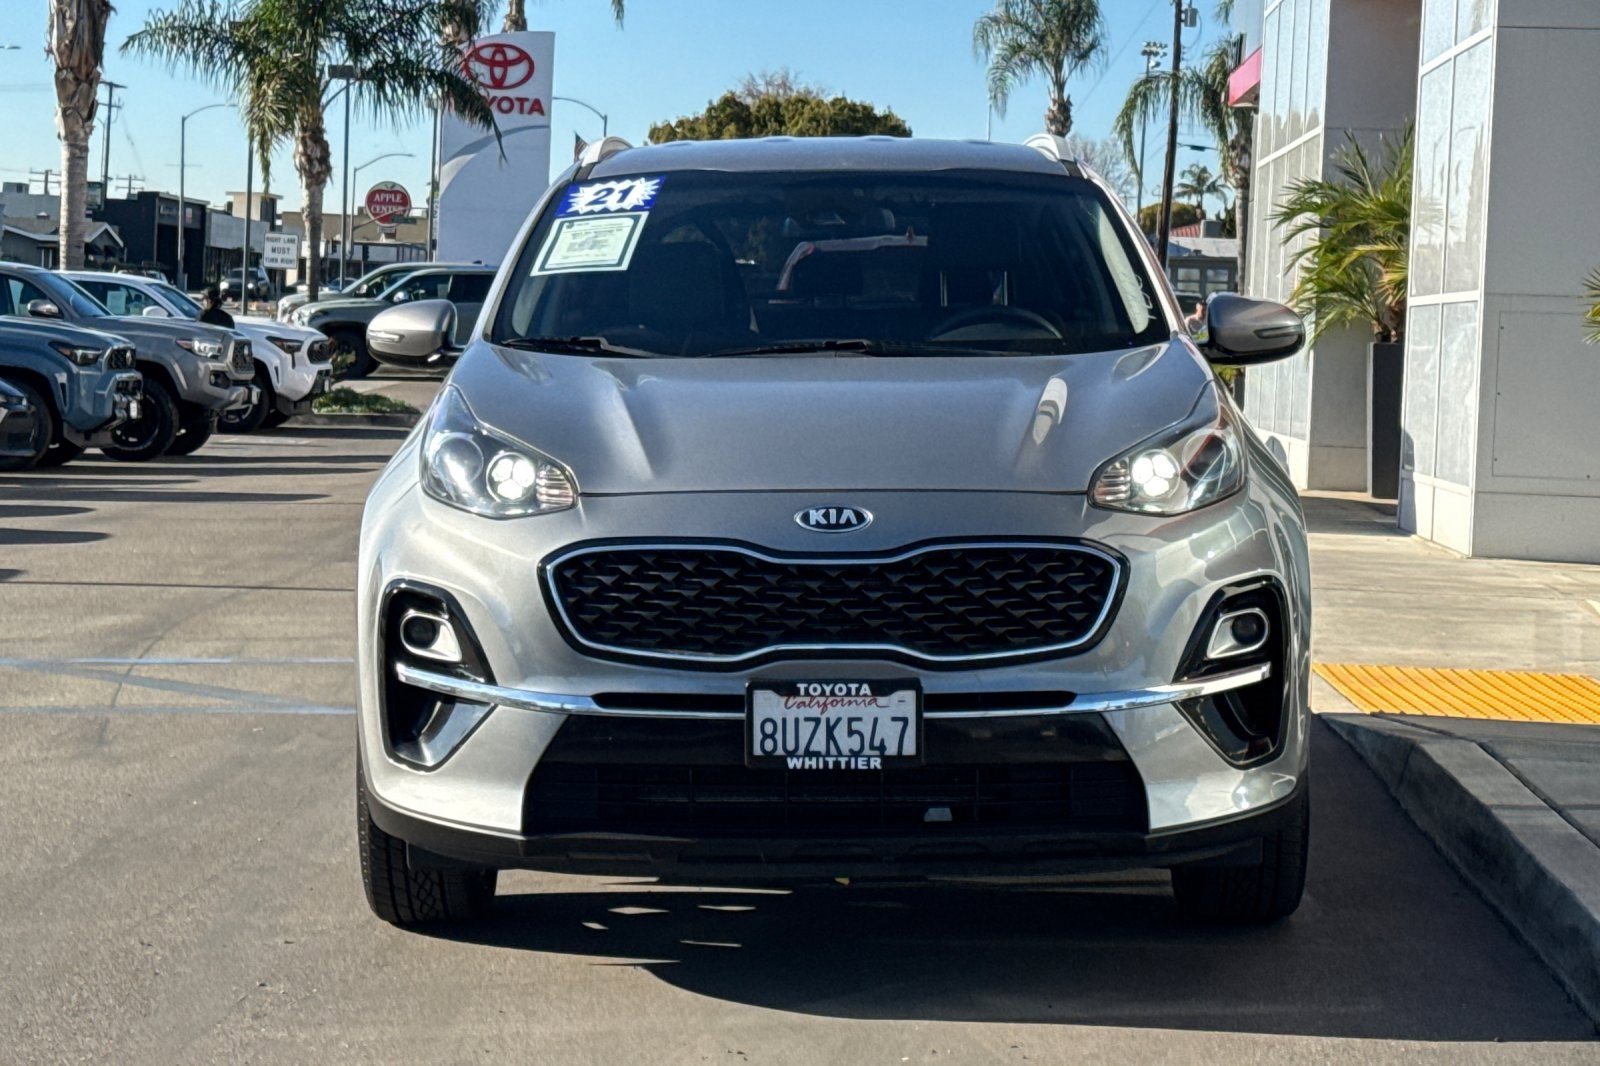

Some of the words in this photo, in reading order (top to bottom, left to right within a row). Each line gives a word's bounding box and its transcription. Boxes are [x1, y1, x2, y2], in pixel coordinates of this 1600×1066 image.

[448, 94, 545, 116] YOTA
[374, 193, 402, 203] APPLE
[584, 185, 636, 207] 21
[271, 246, 291, 255] MUST
[809, 508, 858, 525] KIA
[796, 683, 872, 696] TOYOTA
[784, 696, 890, 715] California
[759, 717, 909, 756] 8UZK547
[787, 756, 882, 770] WHITTIER
